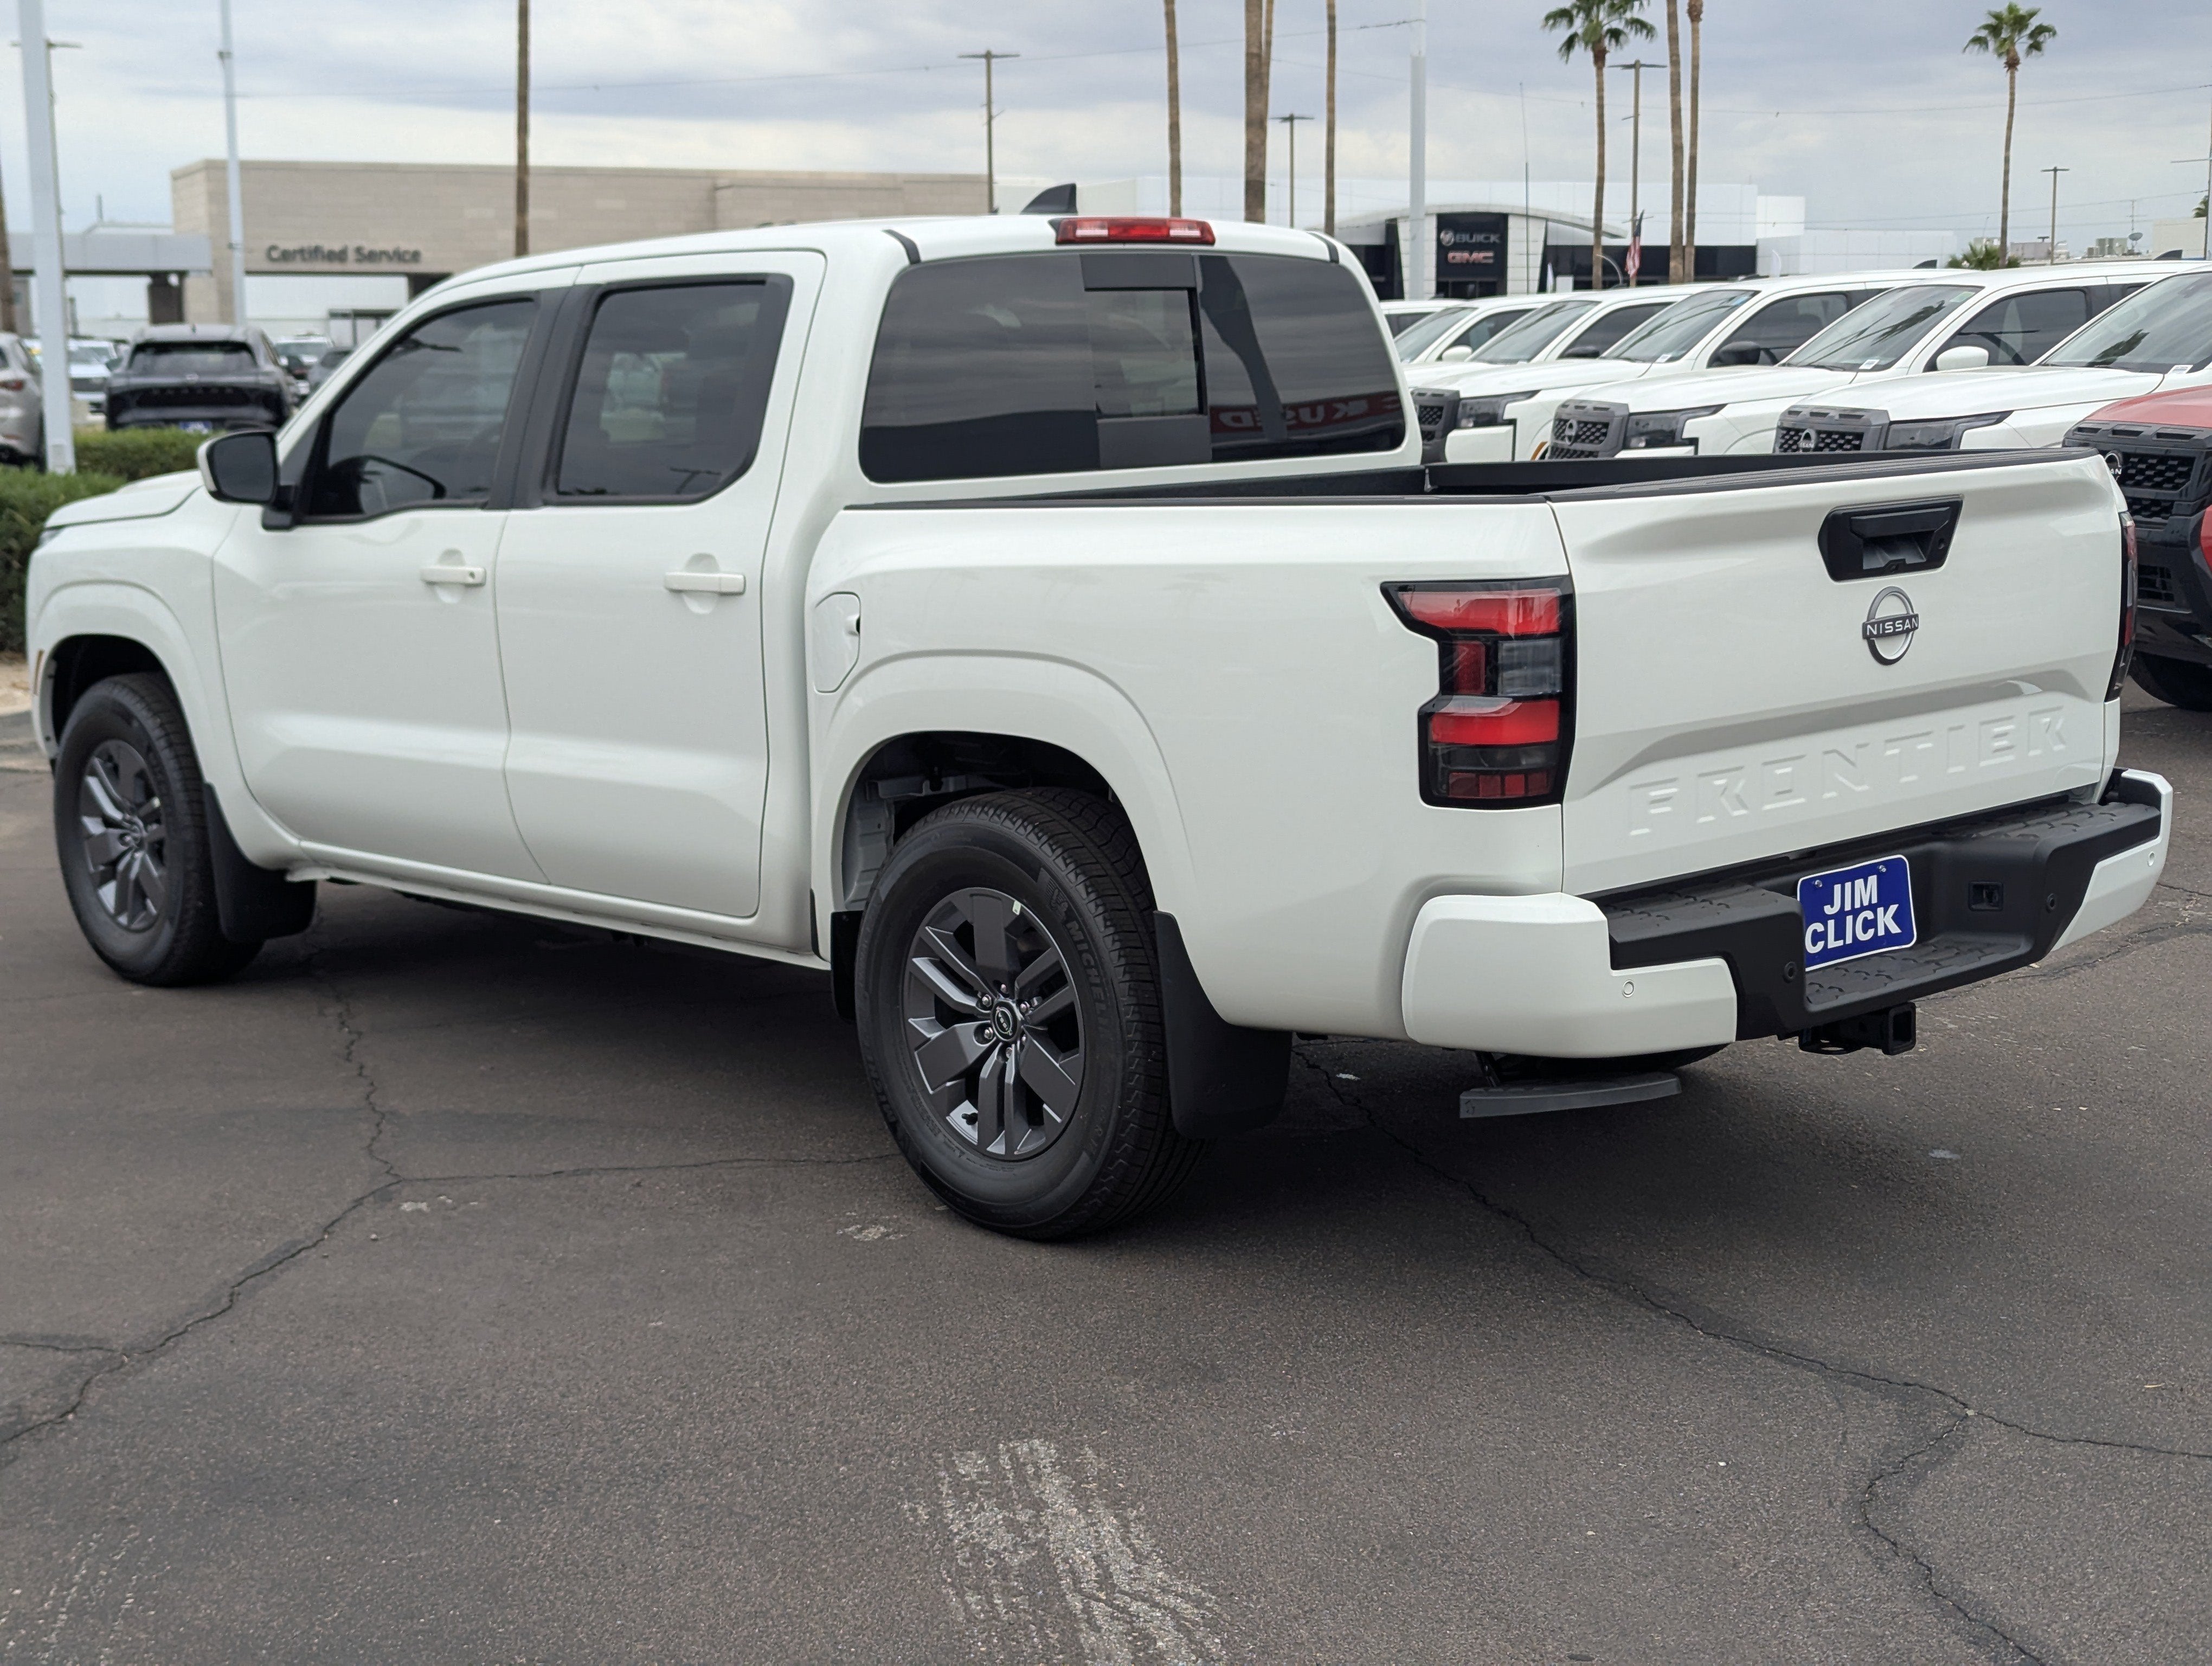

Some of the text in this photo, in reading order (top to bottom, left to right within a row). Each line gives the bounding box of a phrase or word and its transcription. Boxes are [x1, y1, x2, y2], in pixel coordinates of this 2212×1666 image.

[1455, 233, 1501, 243] BUICK
[266, 244, 421, 263] Certified Service
[1447, 251, 1494, 264] GMC
[1867, 617, 1918, 636] NISSAN
[1630, 706, 2066, 836] FRONTIER
[1824, 875, 1877, 915] JIM
[1805, 904, 1902, 953] CLICK
